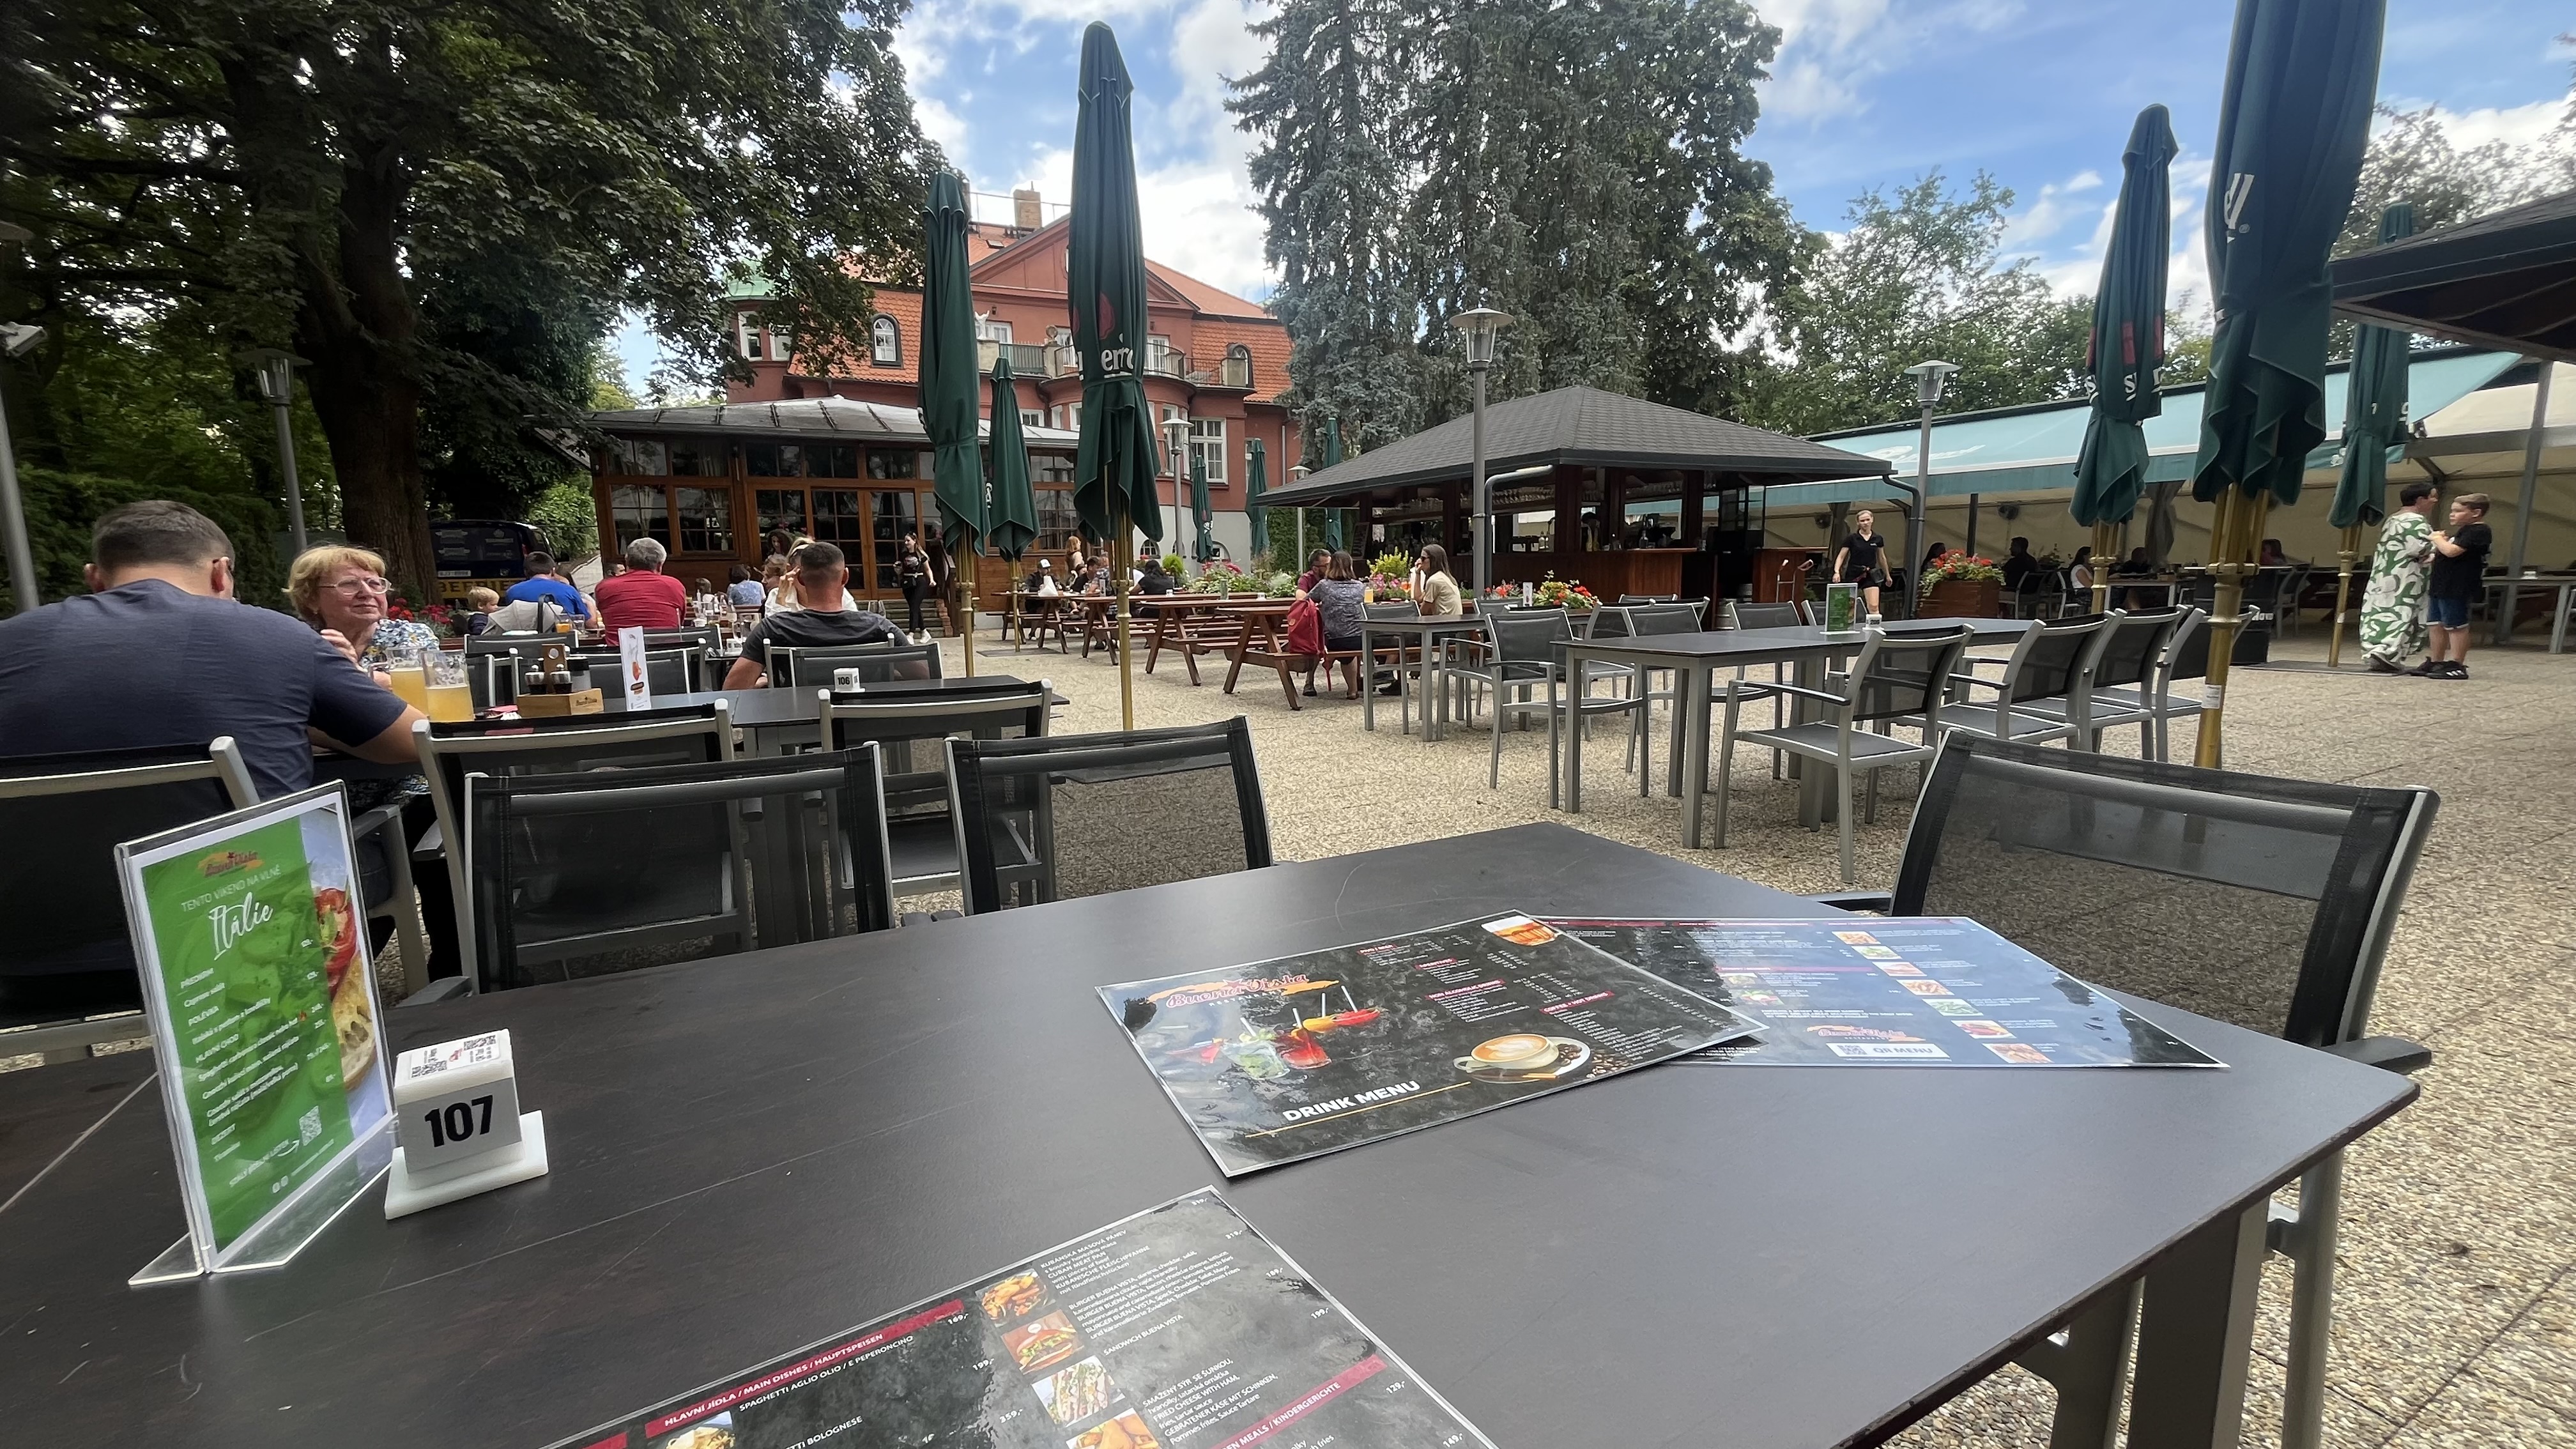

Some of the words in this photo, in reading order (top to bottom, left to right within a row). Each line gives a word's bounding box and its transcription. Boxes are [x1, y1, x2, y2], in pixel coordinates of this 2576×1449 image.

[181, 893, 211, 912] TENTO
[247, 875, 259, 887] NA
[208, 892, 273, 960] Itálie
[1166, 986, 1245, 1008] Buena
[1245, 974, 1309, 992] Vista
[1208, 990, 1283, 1007] RESTAURANT
[1544, 1002, 1568, 1013] COFFEE
[1282, 1092, 1354, 1121] DRINK
[1356, 1079, 1420, 1110] MENU
[424, 1094, 493, 1147] 107
[1048, 1265, 1072, 1278] CUBAN
[1073, 1257, 1091, 1269] MEAT
[1092, 1251, 1107, 1261] PAN
[1049, 1261, 1071, 1272] kousky
[1052, 1275, 1067, 1284] with
[1068, 1267, 1088, 1280] pieces
[1088, 1262, 1096, 1270] of
[1055, 1268, 1099, 1289] KUBANISCHE
[1069, 1297, 1095, 1310] BURGER
[1094, 1286, 1118, 1301] BUENA
[1077, 1308, 1103, 1322] BURGER
[1103, 1298, 1127, 1313] BUENA
[1118, 1301, 1131, 1311] and
[947, 1312, 969, 1324] 169,-
[1085, 1319, 1114, 1334] BURGER
[1114, 1308, 1137, 1322] BUENA
[1090, 1331, 1104, 1340] und
[1103, 1331, 1142, 1355] SANDWICH
[1141, 1322, 1166, 1338] BUENA
[1163, 1314, 1183, 1330] VISTA
[739, 1384, 790, 1412] SPAGHETTI
[790, 1373, 819, 1390] AGLIO
[818, 1364, 842, 1380] OLIO
[848, 1359, 855, 1367] E
[855, 1335, 914, 1365] PEPERONCINO
[972, 1358, 995, 1370] 199,-
[664, 1404, 705, 1426] HLAVNÍ
[707, 1392, 736, 1411] JÍDLA
[744, 1378, 771, 1395] MAIN
[772, 1364, 809, 1383] DISHES
[814, 1333, 884, 1366] HAUPTSPEISEN
[1142, 1383, 1179, 1407] SMAŽENÝ
[1192, 1372, 1202, 1383] SE
[1153, 1407, 1176, 1422] FRIED
[1174, 1395, 1202, 1412] CHEESE
[1200, 1384, 1220, 1397] WITH
[1220, 1374, 1240, 1387] HAM,
[1164, 1408, 1211, 1437] GEBRATENER
[1228, 1391, 1243, 1404] MIT
[1242, 1373, 1278, 1395] SCHINKEN,
[1193, 1398, 1213, 1412] sauce
[1169, 1425, 1202, 1445] Pommes
[1218, 1406, 1239, 1420] Sauce
[1238, 1393, 1261, 1409] Tartare
[1239, 1425, 1269, 1446] MEALS
[1273, 1381, 1341, 1426] KINDERGERICHTE
[806, 1415, 862, 1446] BOLOGNESE
[1318, 1434, 1335, 1448] fries
